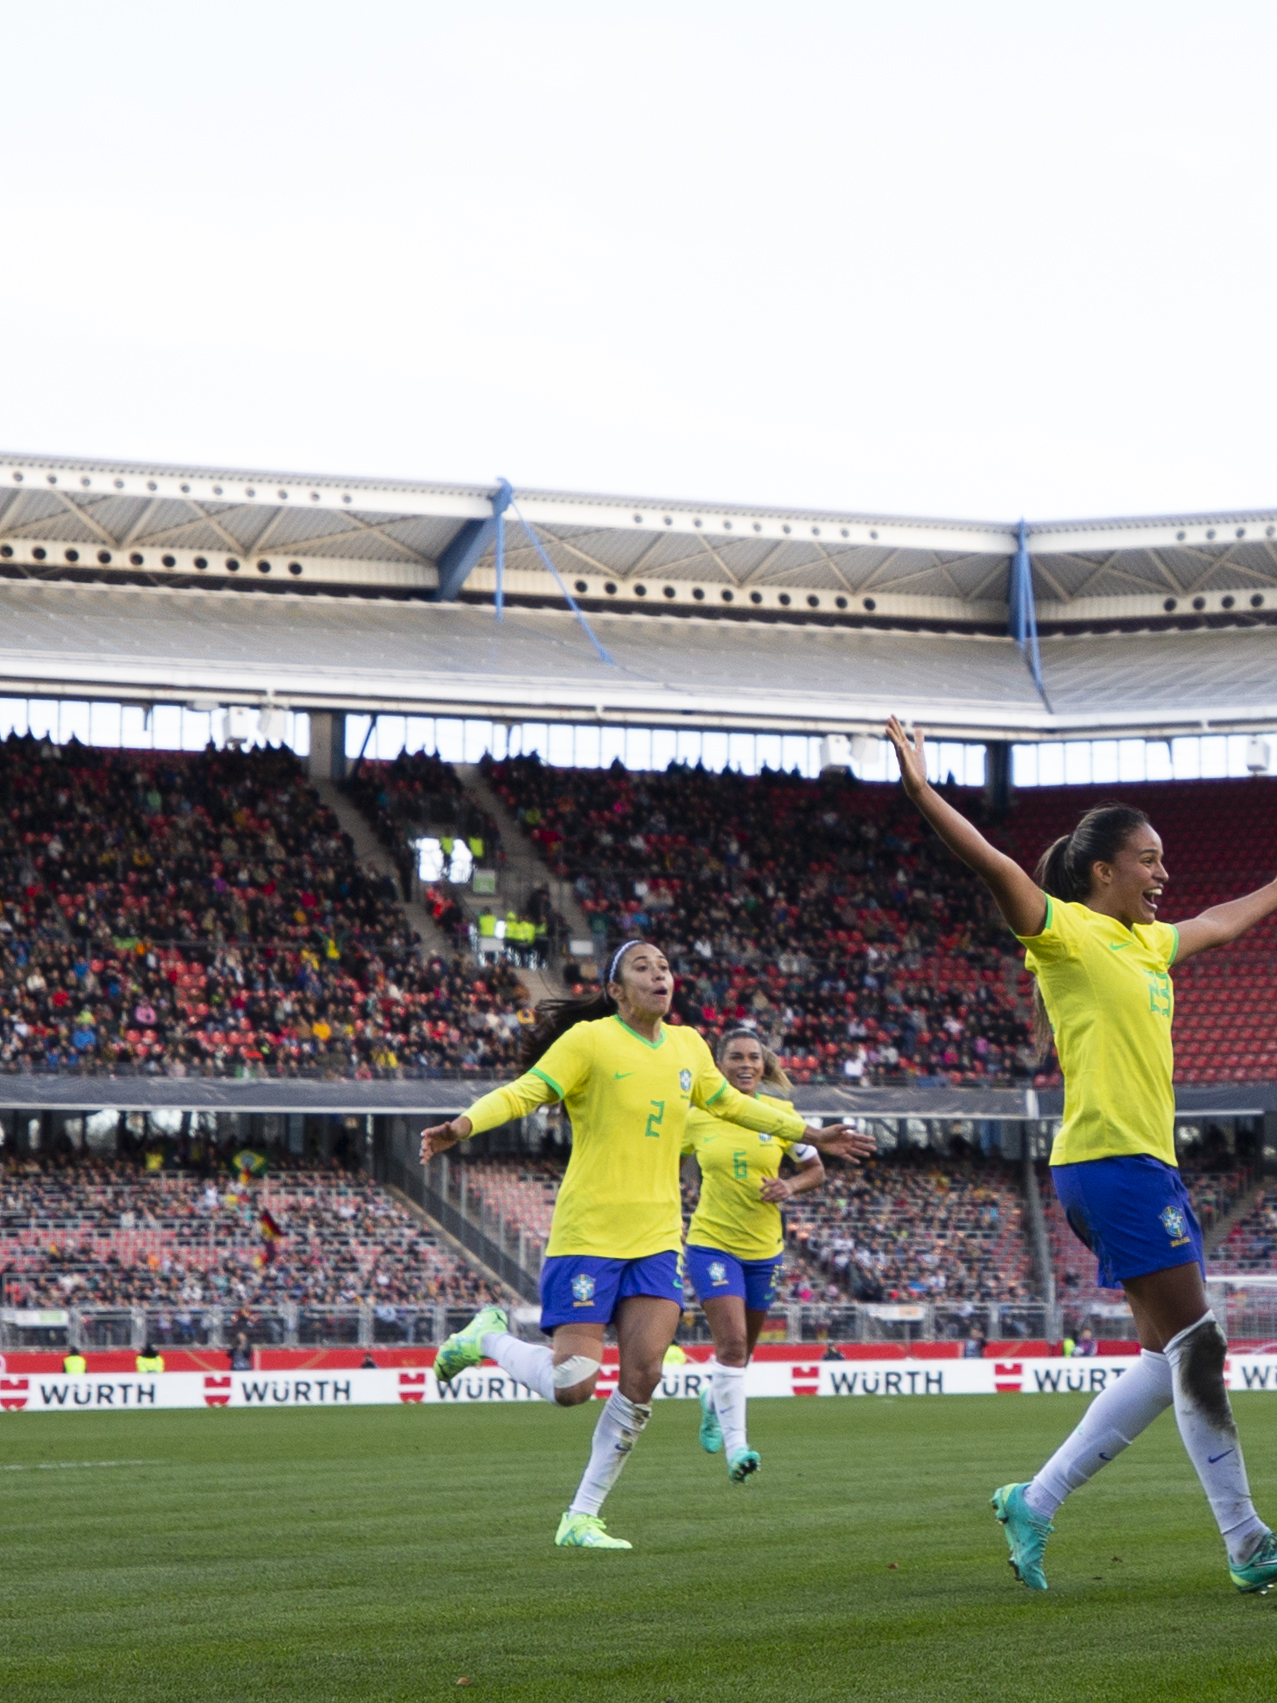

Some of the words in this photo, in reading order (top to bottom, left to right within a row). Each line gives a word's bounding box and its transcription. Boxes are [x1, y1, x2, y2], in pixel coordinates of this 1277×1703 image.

[645, 1100, 665, 1138] 2
[733, 1151, 748, 1180] 6
[243, 1379, 350, 1403] WÜRTH
[437, 1377, 532, 1399] WÜRT
[831, 1369, 943, 1394] WÜRTH
[1034, 1367, 1128, 1392] WÜRT
[41, 1383, 155, 1405] WÜRTH
